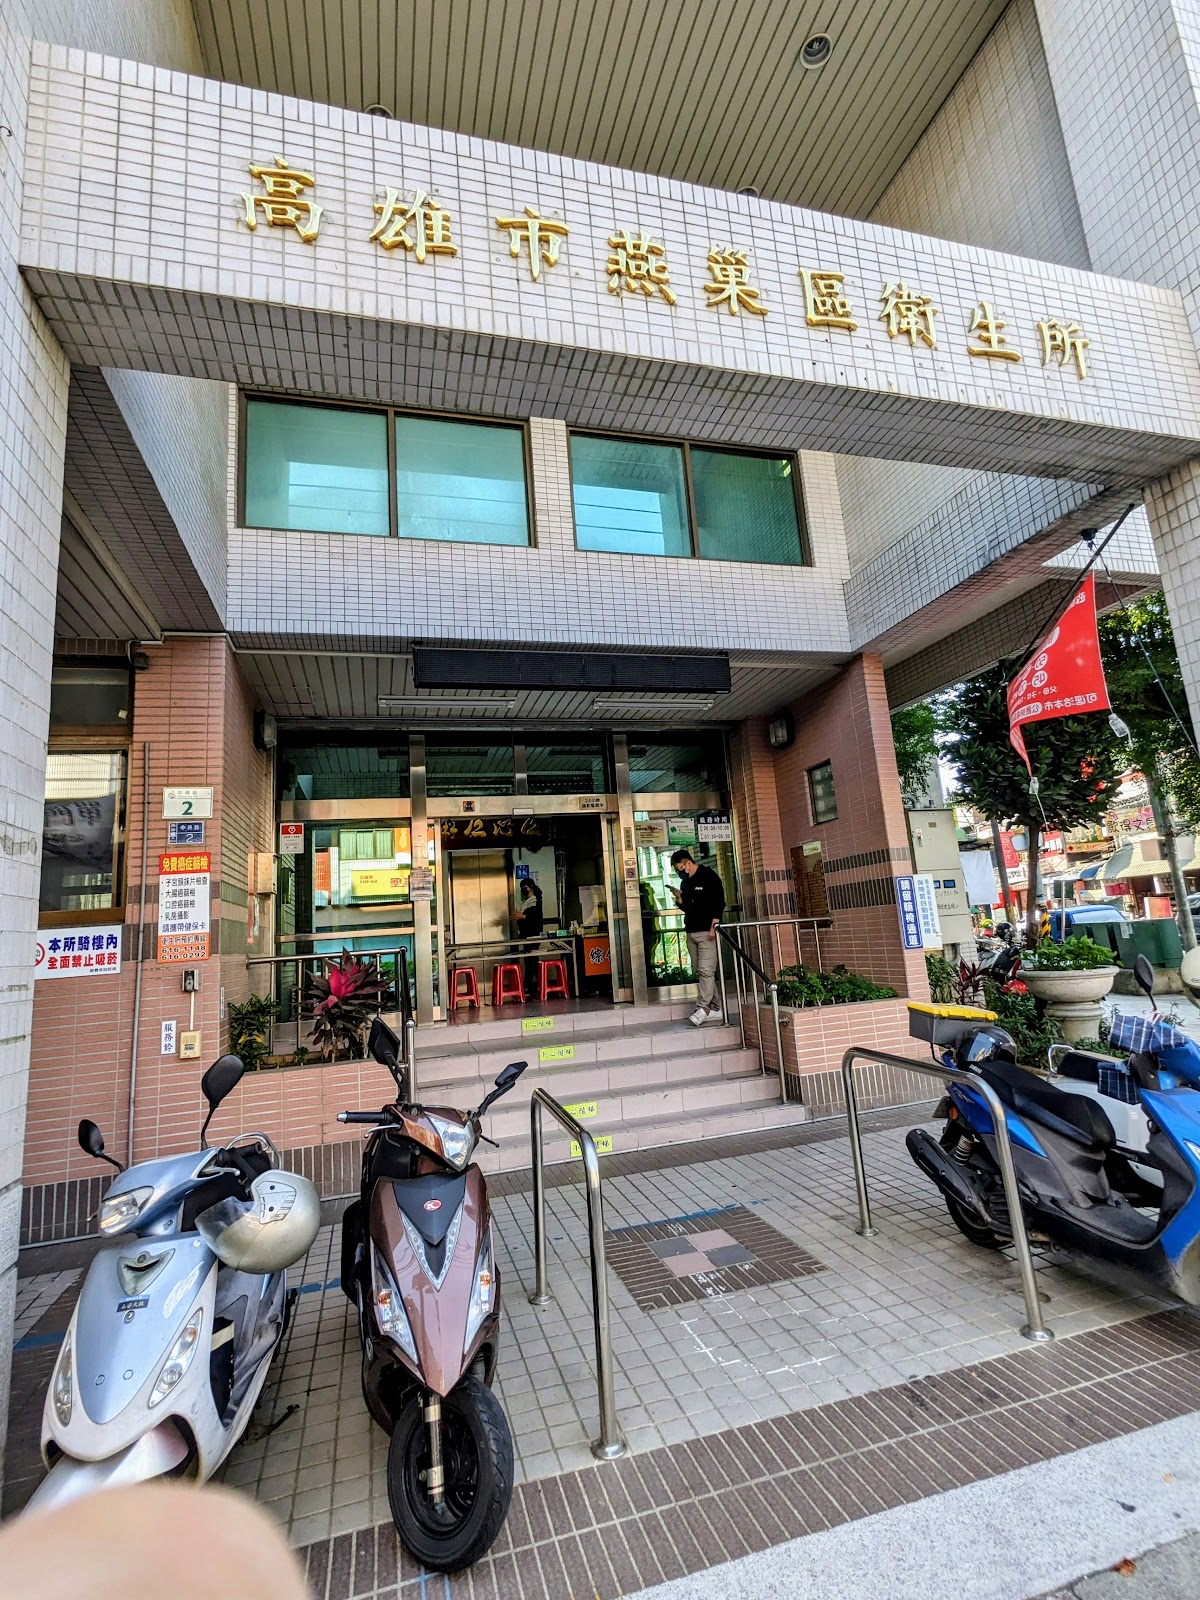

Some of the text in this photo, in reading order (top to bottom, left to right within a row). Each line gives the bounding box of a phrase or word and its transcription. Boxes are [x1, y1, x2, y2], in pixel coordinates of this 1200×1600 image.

[239, 156, 1091, 380] 高雄市燕巢區衛生所
[181, 801, 193, 815] 2
[700, 816, 728, 824] 服務時間
[186, 833, 194, 842] 2
[162, 855, 209, 872] 免費癌症篩檢
[165, 888, 196, 898] 大腸癌篩檢
[165, 899, 196, 909] 口腔癌篩檢
[917, 879, 931, 934] 保險套自動服務機
[165, 910, 190, 921] 乳房攝影
[900, 879, 919, 946] 請留輪椅通道
[162, 921, 206, 933] 請攜帶健保卡
[48, 933, 118, 953] 本所騎樓內
[47, 952, 118, 970] 全面禁止吸菸
[162, 952, 206, 961] 616-0292
[523, 1020, 552, 1028] 小心階梯
[163, 1023, 173, 1052] 服務鈴
[541, 1049, 573, 1058] 小心階梯
[573, 1139, 610, 1152] 小階梯
